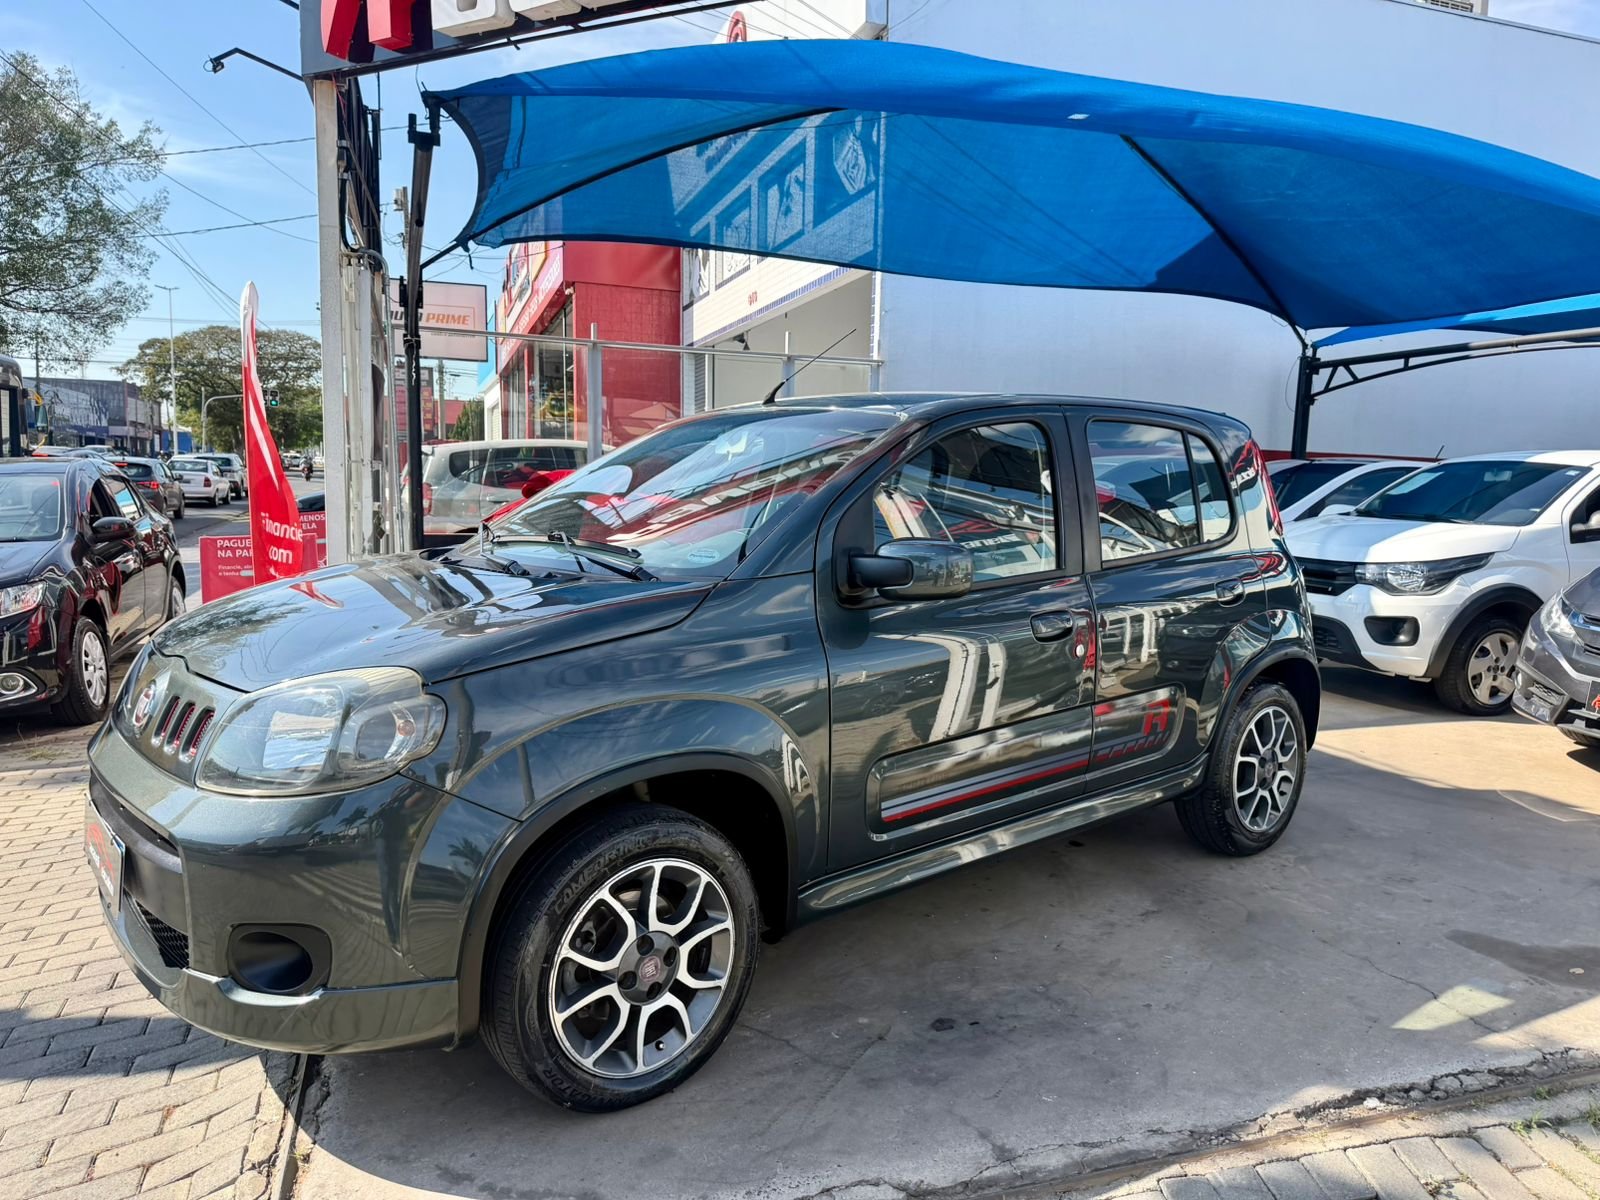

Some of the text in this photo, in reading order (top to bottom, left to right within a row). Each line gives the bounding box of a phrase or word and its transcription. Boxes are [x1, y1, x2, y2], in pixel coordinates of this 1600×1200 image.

[425, 312, 470, 325] PRIME
[217, 539, 252, 548] PAGUE
[217, 549, 233, 558] NA
